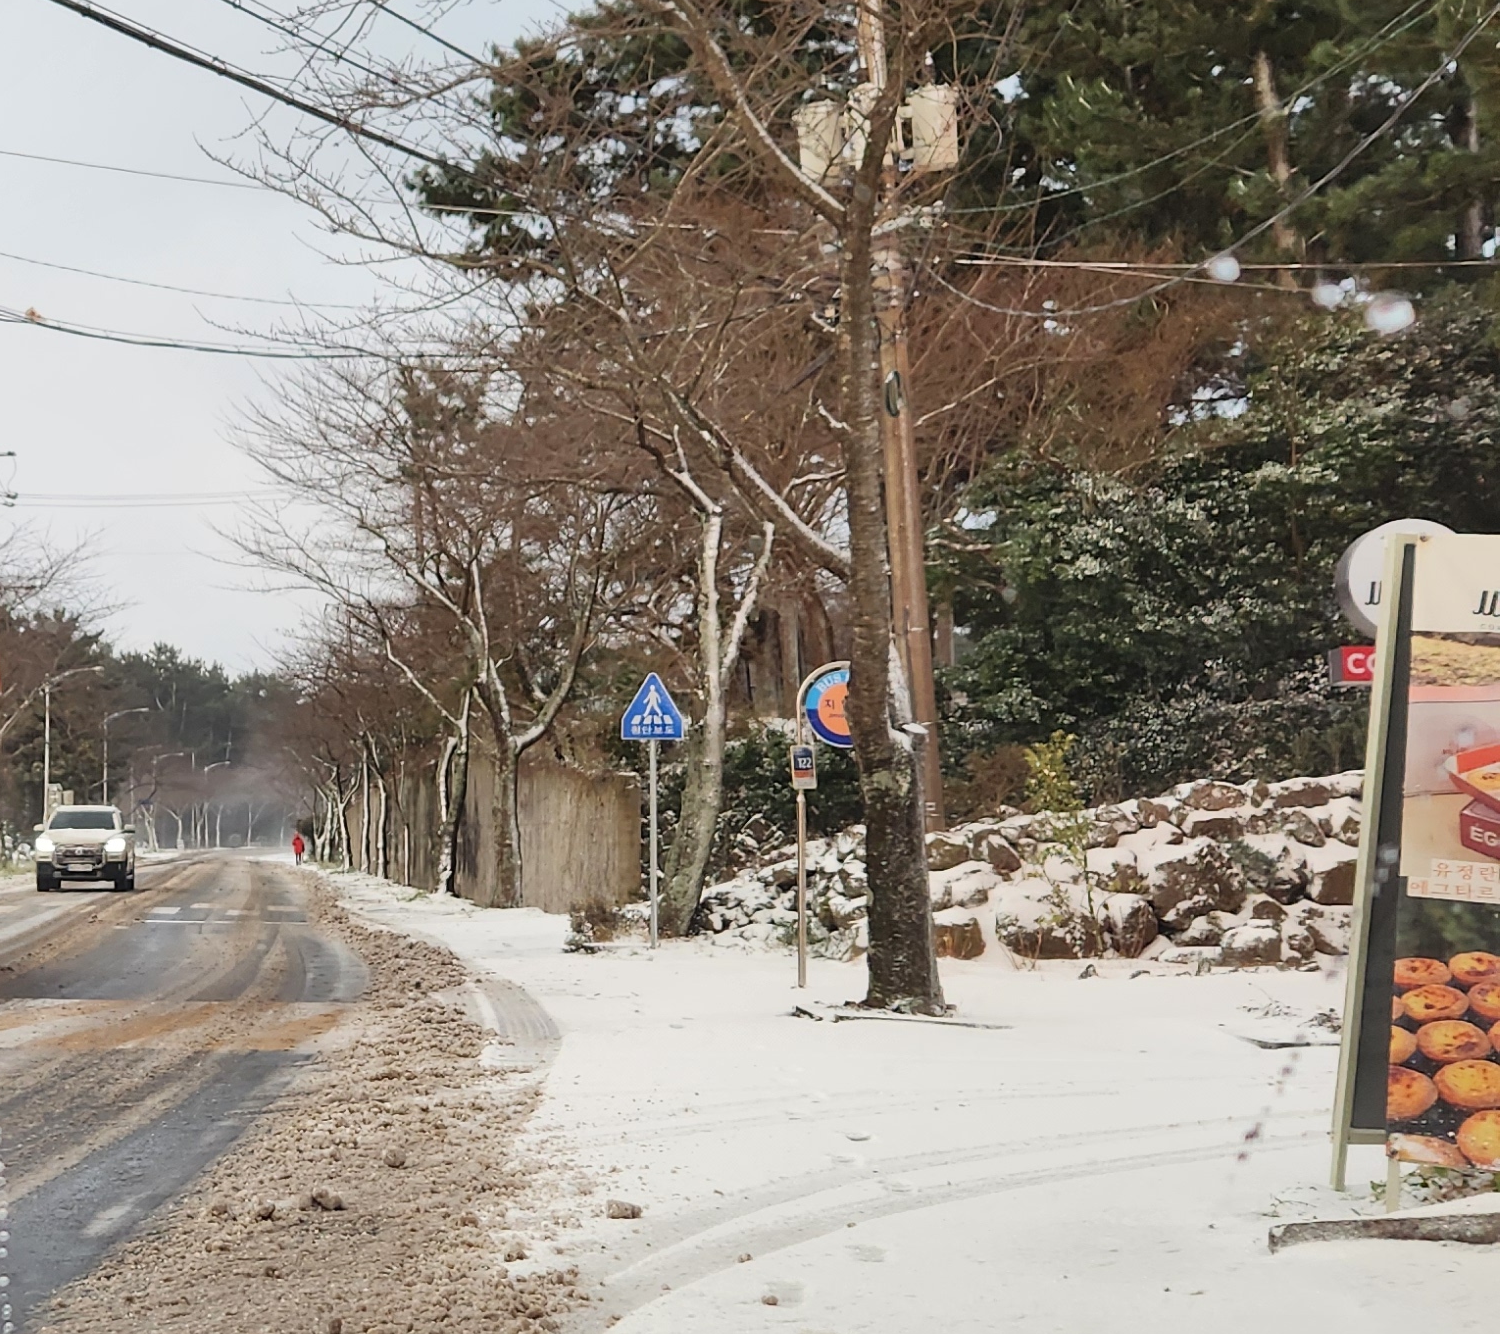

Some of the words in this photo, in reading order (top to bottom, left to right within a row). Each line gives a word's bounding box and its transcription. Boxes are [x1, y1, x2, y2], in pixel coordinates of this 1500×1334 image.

[816, 673, 841, 693] BUS
[1469, 826, 1500, 847] EG
[1433, 862, 1498, 882] 유정란
[1410, 880, 1500, 900] 에그타르
